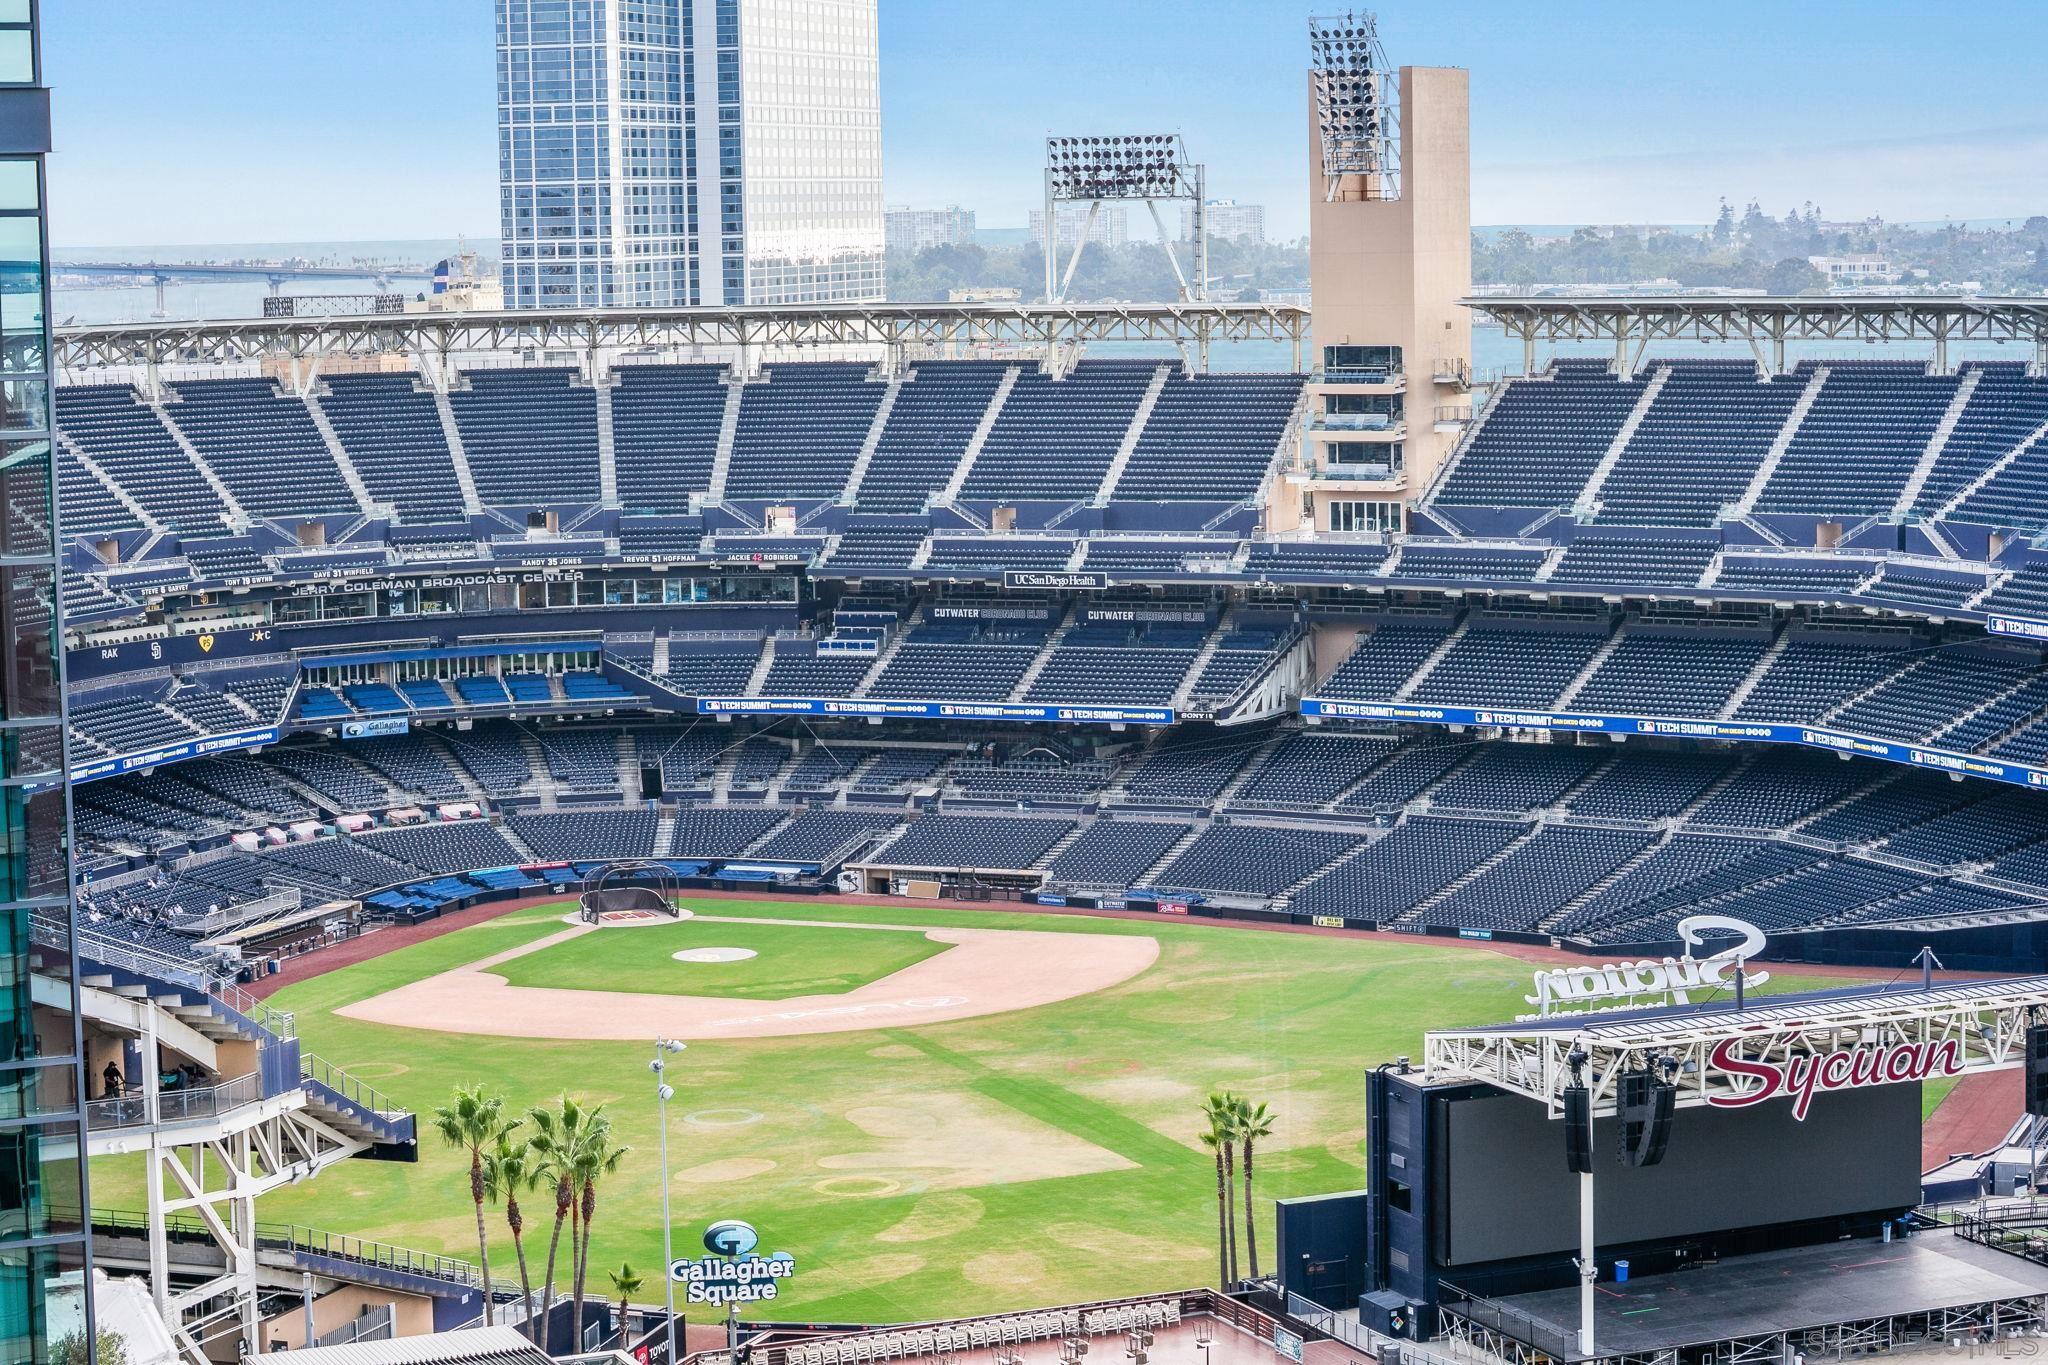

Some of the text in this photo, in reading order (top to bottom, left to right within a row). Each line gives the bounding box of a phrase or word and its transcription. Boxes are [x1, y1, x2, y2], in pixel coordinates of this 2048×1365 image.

[547, 558, 557, 566] 35
[559, 557, 582, 565] JONES
[651, 555, 661, 563] 51
[727, 553, 798, 561] JACKIE 42 ROBINSON
[313, 568, 374, 579] DAVE 31 WINFIELD
[224, 576, 273, 587] TONY 19 GWYNN
[291, 571, 584, 597] JERRY COLEMAN BROADCAST CENTER
[1014, 574, 1096, 587] UC San Diego Health
[141, 587, 159, 596] STEVE
[934, 608, 1049, 619] CUTWATER CORONADO CLUB
[1088, 610, 1134, 620] CUTWATER
[1135, 611, 1182, 621] CORONADO
[2005, 620, 2024, 634] TECH
[101, 648, 118, 659] RAK
[720, 701, 741, 709] TECH
[741, 701, 771, 710] SUMMIT
[838, 703, 858, 712] TECH
[858, 704, 886, 712] SUMMIT
[954, 706, 974, 715] TECH
[974, 707, 1004, 716] SUMMIT
[1337, 704, 1360, 715] TECH
[1360, 705, 1395, 717] SUMMIT
[1073, 710, 1092, 719] TECH
[1093, 711, 1123, 720] SUMMIT
[1492, 713, 1516, 724] TECH
[1516, 714, 1553, 727] SUMMIT
[368, 720, 407, 731] Gallagher
[1655, 722, 1680, 733] TECH
[1680, 723, 1718, 735] SUMMIT
[1814, 733, 1830, 746] TECH
[1830, 735, 1855, 750] SUMMIT
[1924, 752, 1940, 766] TECH
[1940, 756, 1967, 770] SUMMIT
[1708, 1022, 1966, 1121] Sycuan
[670, 1256, 796, 1285] Gallagher
[687, 1281, 778, 1307] Square
[649, 1339, 670, 1359] TOYOT
